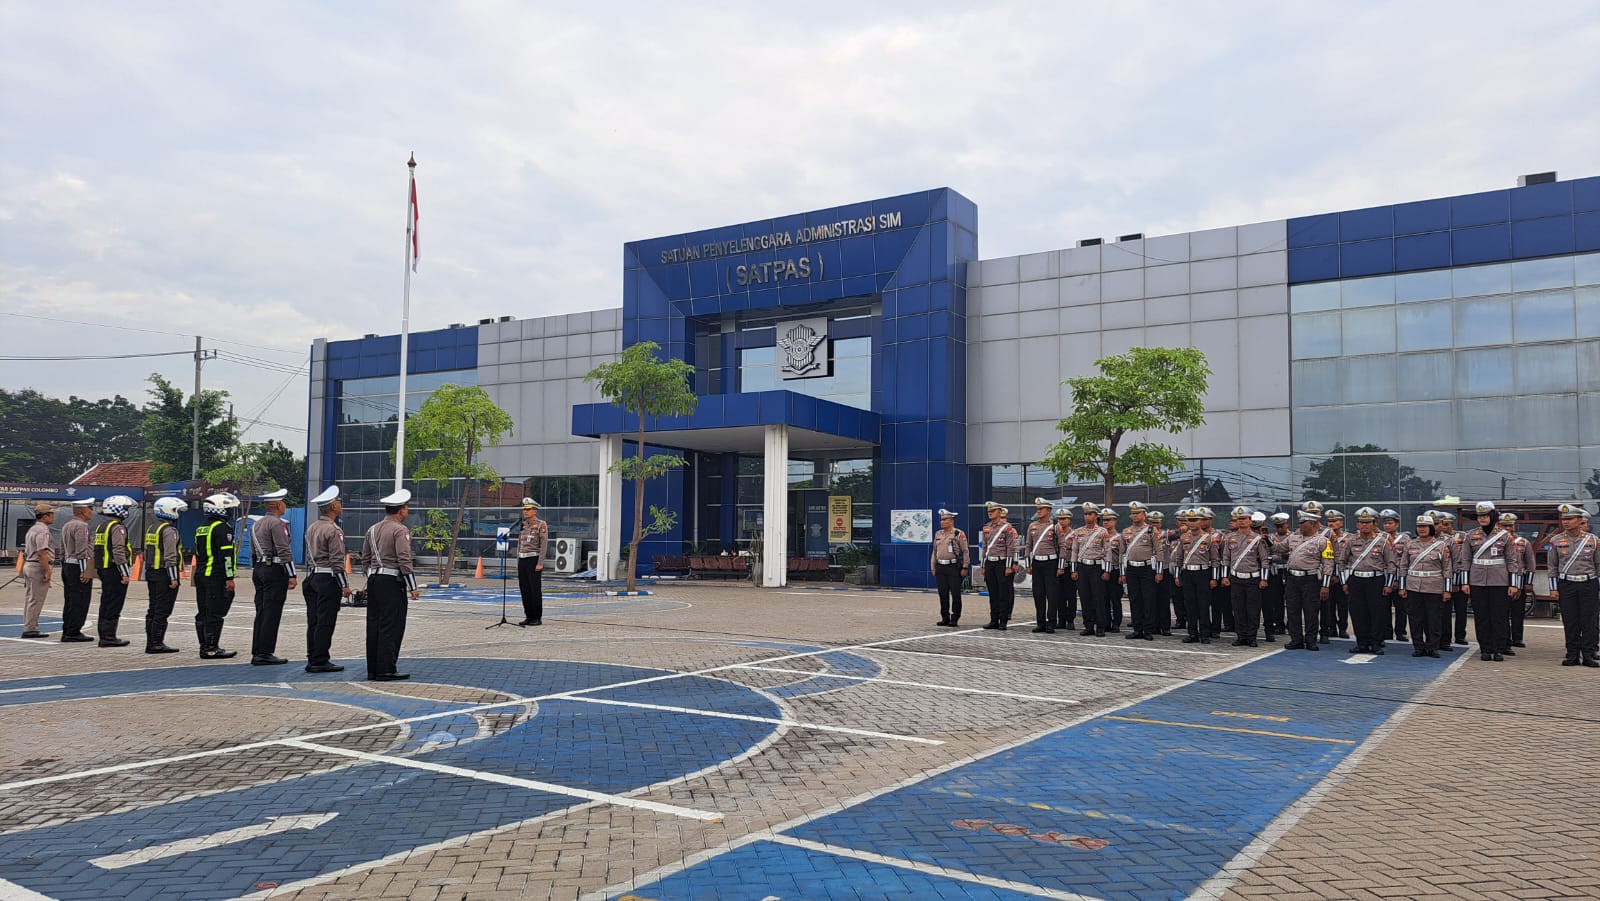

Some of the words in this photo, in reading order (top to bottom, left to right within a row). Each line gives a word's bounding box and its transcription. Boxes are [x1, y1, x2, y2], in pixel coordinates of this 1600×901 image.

[661, 244, 700, 265] SATUAN
[703, 232, 792, 258] PENYELENGGARA
[796, 216, 876, 244] ADMINISTRASI
[879, 211, 902, 230] SIM
